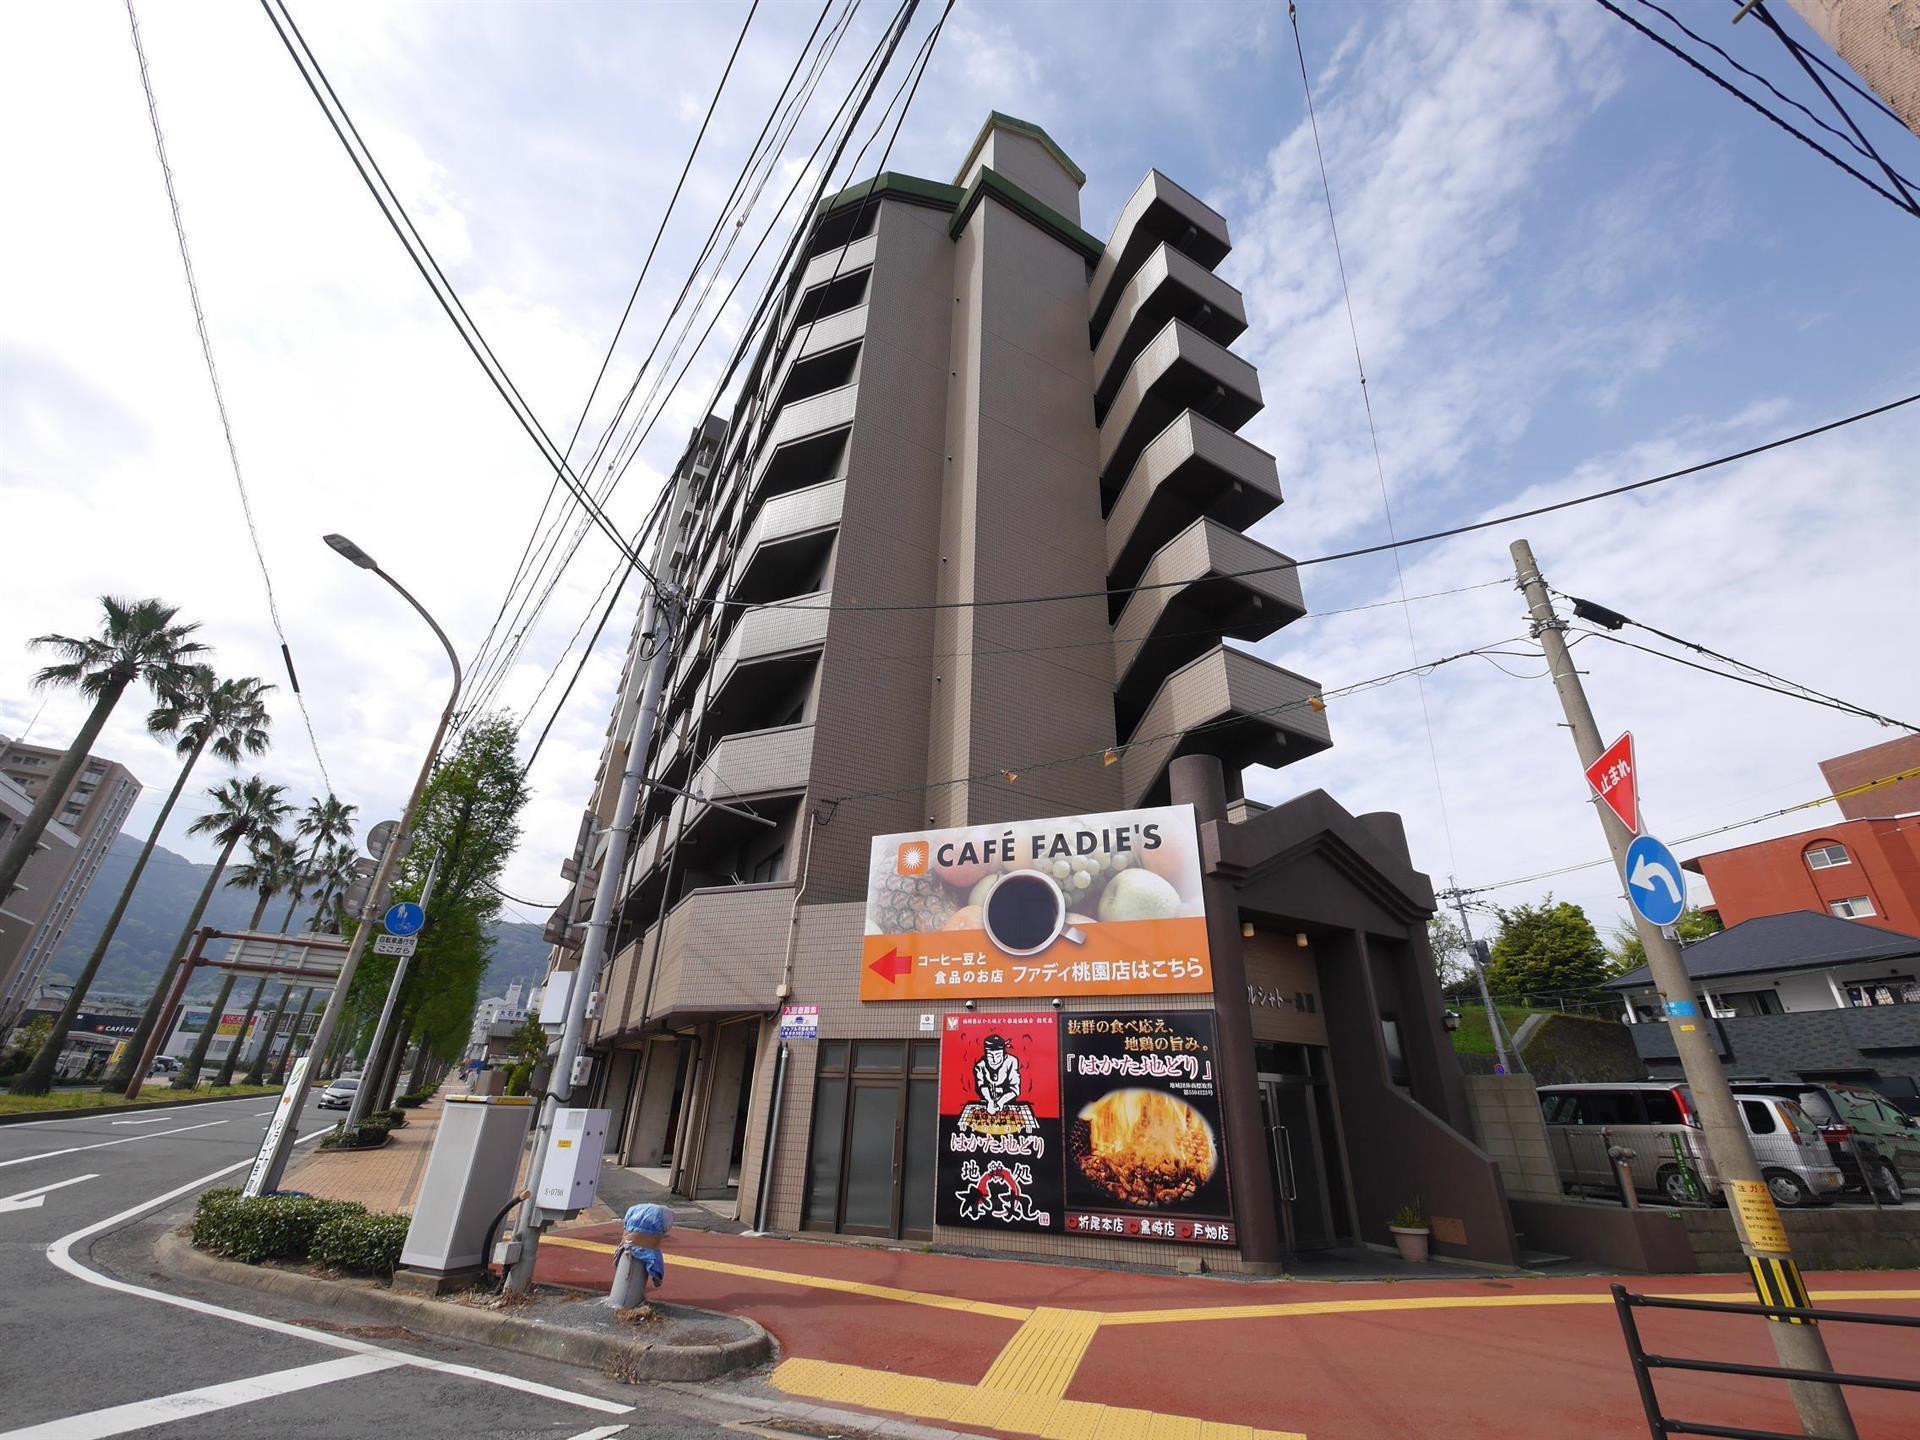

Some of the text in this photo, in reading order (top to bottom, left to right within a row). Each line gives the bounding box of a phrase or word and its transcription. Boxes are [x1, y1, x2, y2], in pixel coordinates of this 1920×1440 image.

[1600, 759, 1631, 794] 止まれ
[936, 823, 1162, 867] CAFÉ FADIE'S
[377, 945, 410, 955] ここから
[917, 952, 987, 967] コーヒー豆と
[934, 969, 1004, 985] 食品のお店
[1012, 957, 1204, 983] ファディ桃園店はこちら
[1067, 1019, 1174, 1035] 抜群の食べ応え、
[1124, 1036, 1209, 1052] 地鶏の旨み。
[950, 1132, 1045, 1159] はかた地どり
[1078, 1215, 1229, 1241] 折尾本店 黒崎店 戸畑店
